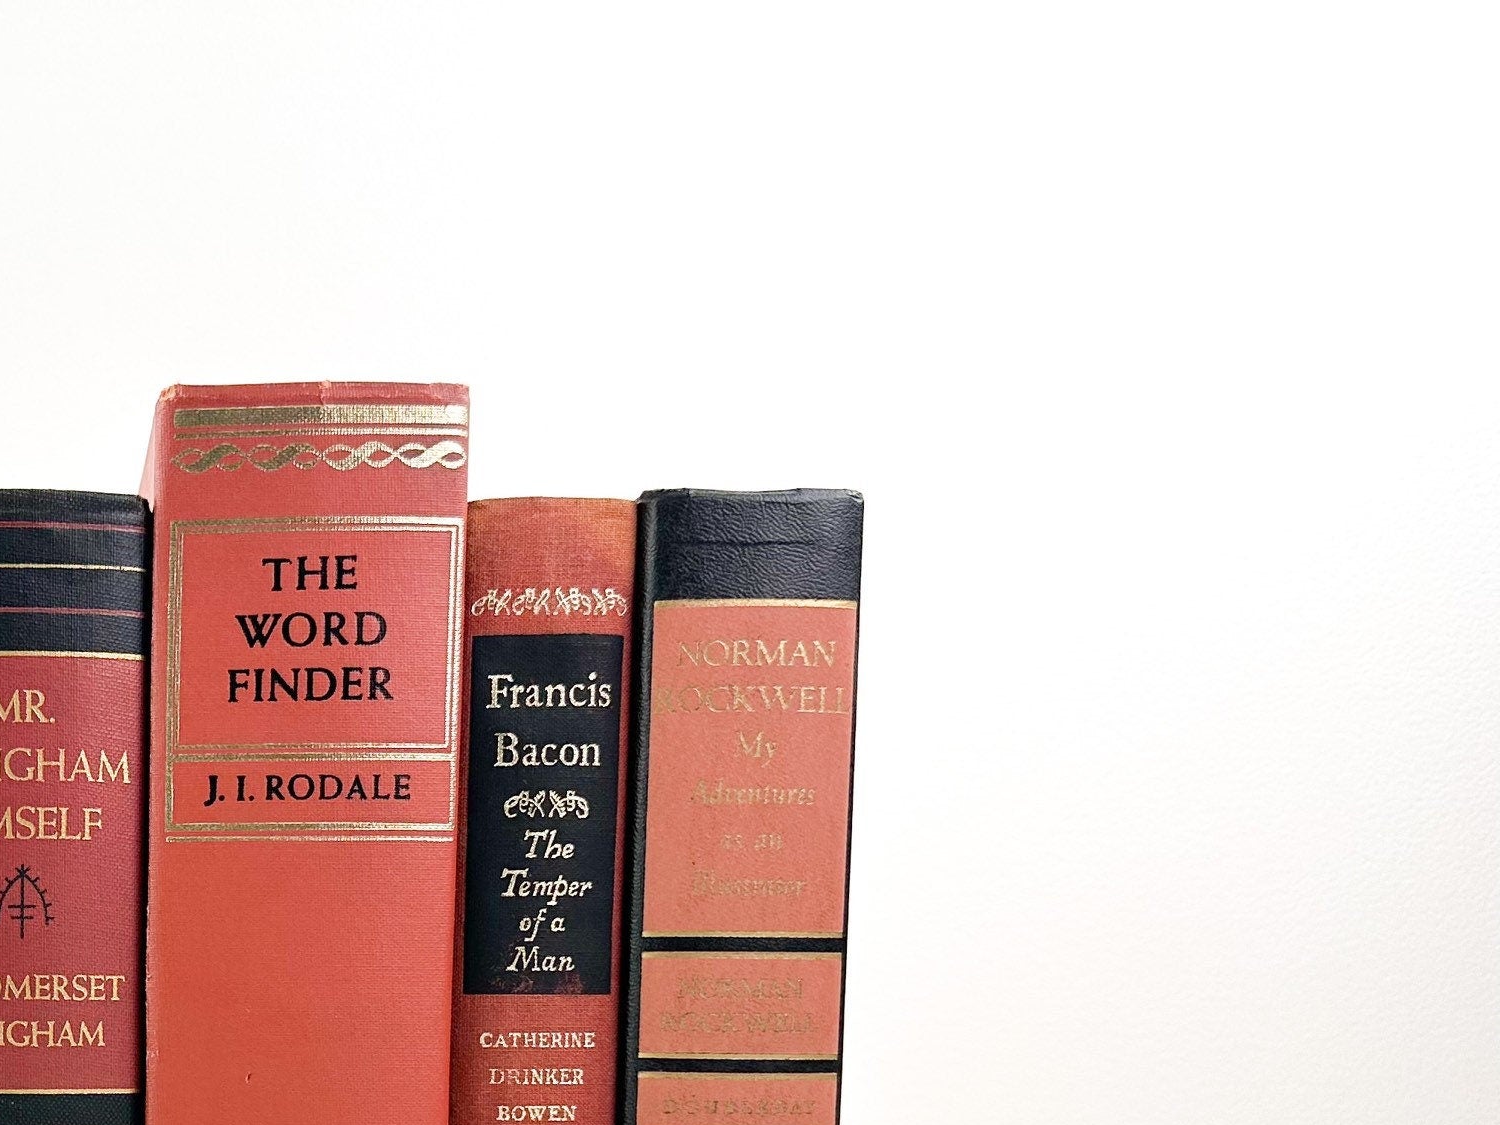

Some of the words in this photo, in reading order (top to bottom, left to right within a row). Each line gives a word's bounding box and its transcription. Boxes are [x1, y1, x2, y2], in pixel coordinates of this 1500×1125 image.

[261, 555, 358, 592] THE
[235, 611, 388, 649] WORD
[677, 639, 837, 668] NORMAN
[227, 667, 394, 703] FINDER
[485, 671, 612, 709] Francis
[494, 732, 601, 768] Bacon
[738, 730, 777, 768] My
[203, 775, 226, 807] J.
[236, 775, 255, 802] I.
[265, 773, 411, 802] RODALE
[523, 828, 575, 860] The
[500, 868, 593, 906] Temper
[519, 908, 546, 942] of
[550, 916, 566, 932] a
[505, 946, 575, 972] Man
[480, 1032, 596, 1048] CATHERINE
[489, 1068, 584, 1085] DRINKER
[496, 1105, 577, 1121] BOWEN
